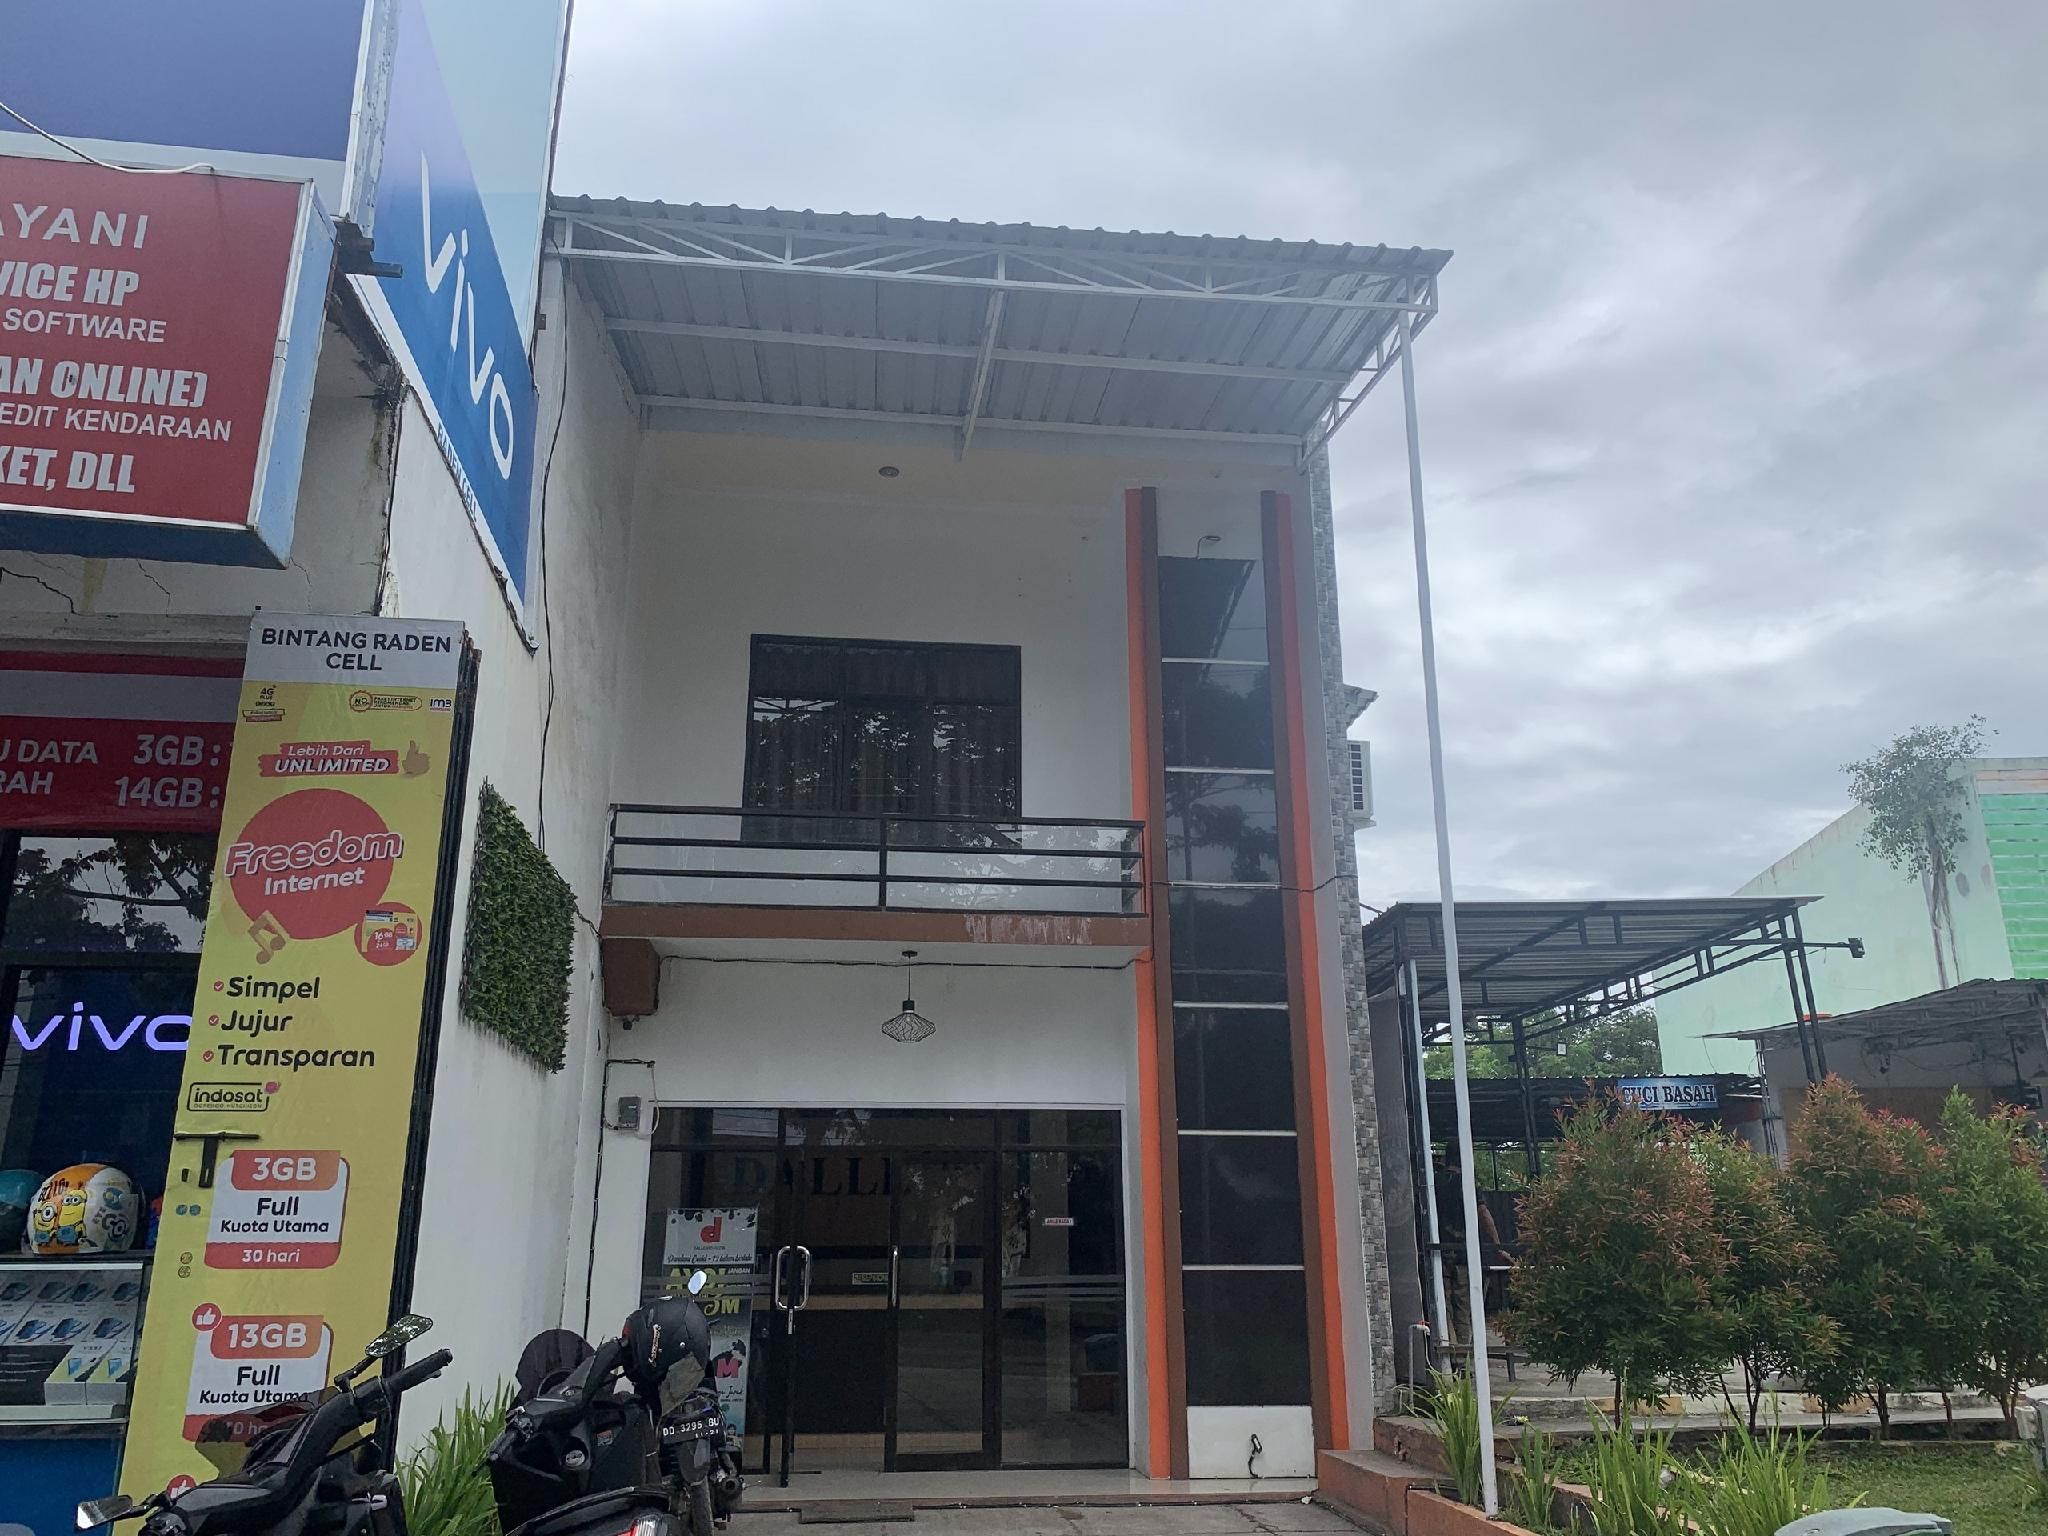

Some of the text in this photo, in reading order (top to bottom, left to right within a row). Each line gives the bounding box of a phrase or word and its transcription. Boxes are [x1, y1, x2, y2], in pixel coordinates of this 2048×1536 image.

[0, 203, 148, 249] YANI
[83, 268, 139, 306] HP
[3, 308, 167, 343] SOFTWARE
[421, 150, 513, 480] vivo
[50, 360, 208, 408] ONLINE)
[64, 407, 232, 442] KENDARAAN
[66, 451, 135, 493] DLL
[261, 628, 451, 652] BINTANG RADEN
[326, 652, 382, 671] CELL
[18, 740, 98, 764] DATA
[288, 744, 365, 756] Lebih Dari
[275, 758, 391, 773] UNLIMITED
[224, 829, 404, 878] Freedom
[264, 867, 366, 896] Internet
[226, 975, 320, 1004] Simpel
[221, 1009, 293, 1038] Jujur
[218, 1044, 375, 1072] Transparan
[194, 1088, 263, 1103] indosat
[1662, 1084, 1717, 1103] BASAH
[252, 1157, 317, 1182] 3GB
[256, 1196, 300, 1216] Full
[220, 1219, 329, 1233] Kuota Utama
[242, 1249, 301, 1263] 30 hari
[228, 1323, 307, 1349] 13GB
[236, 1364, 281, 1386] Full
[200, 1390, 308, 1404] Kuota Utama
